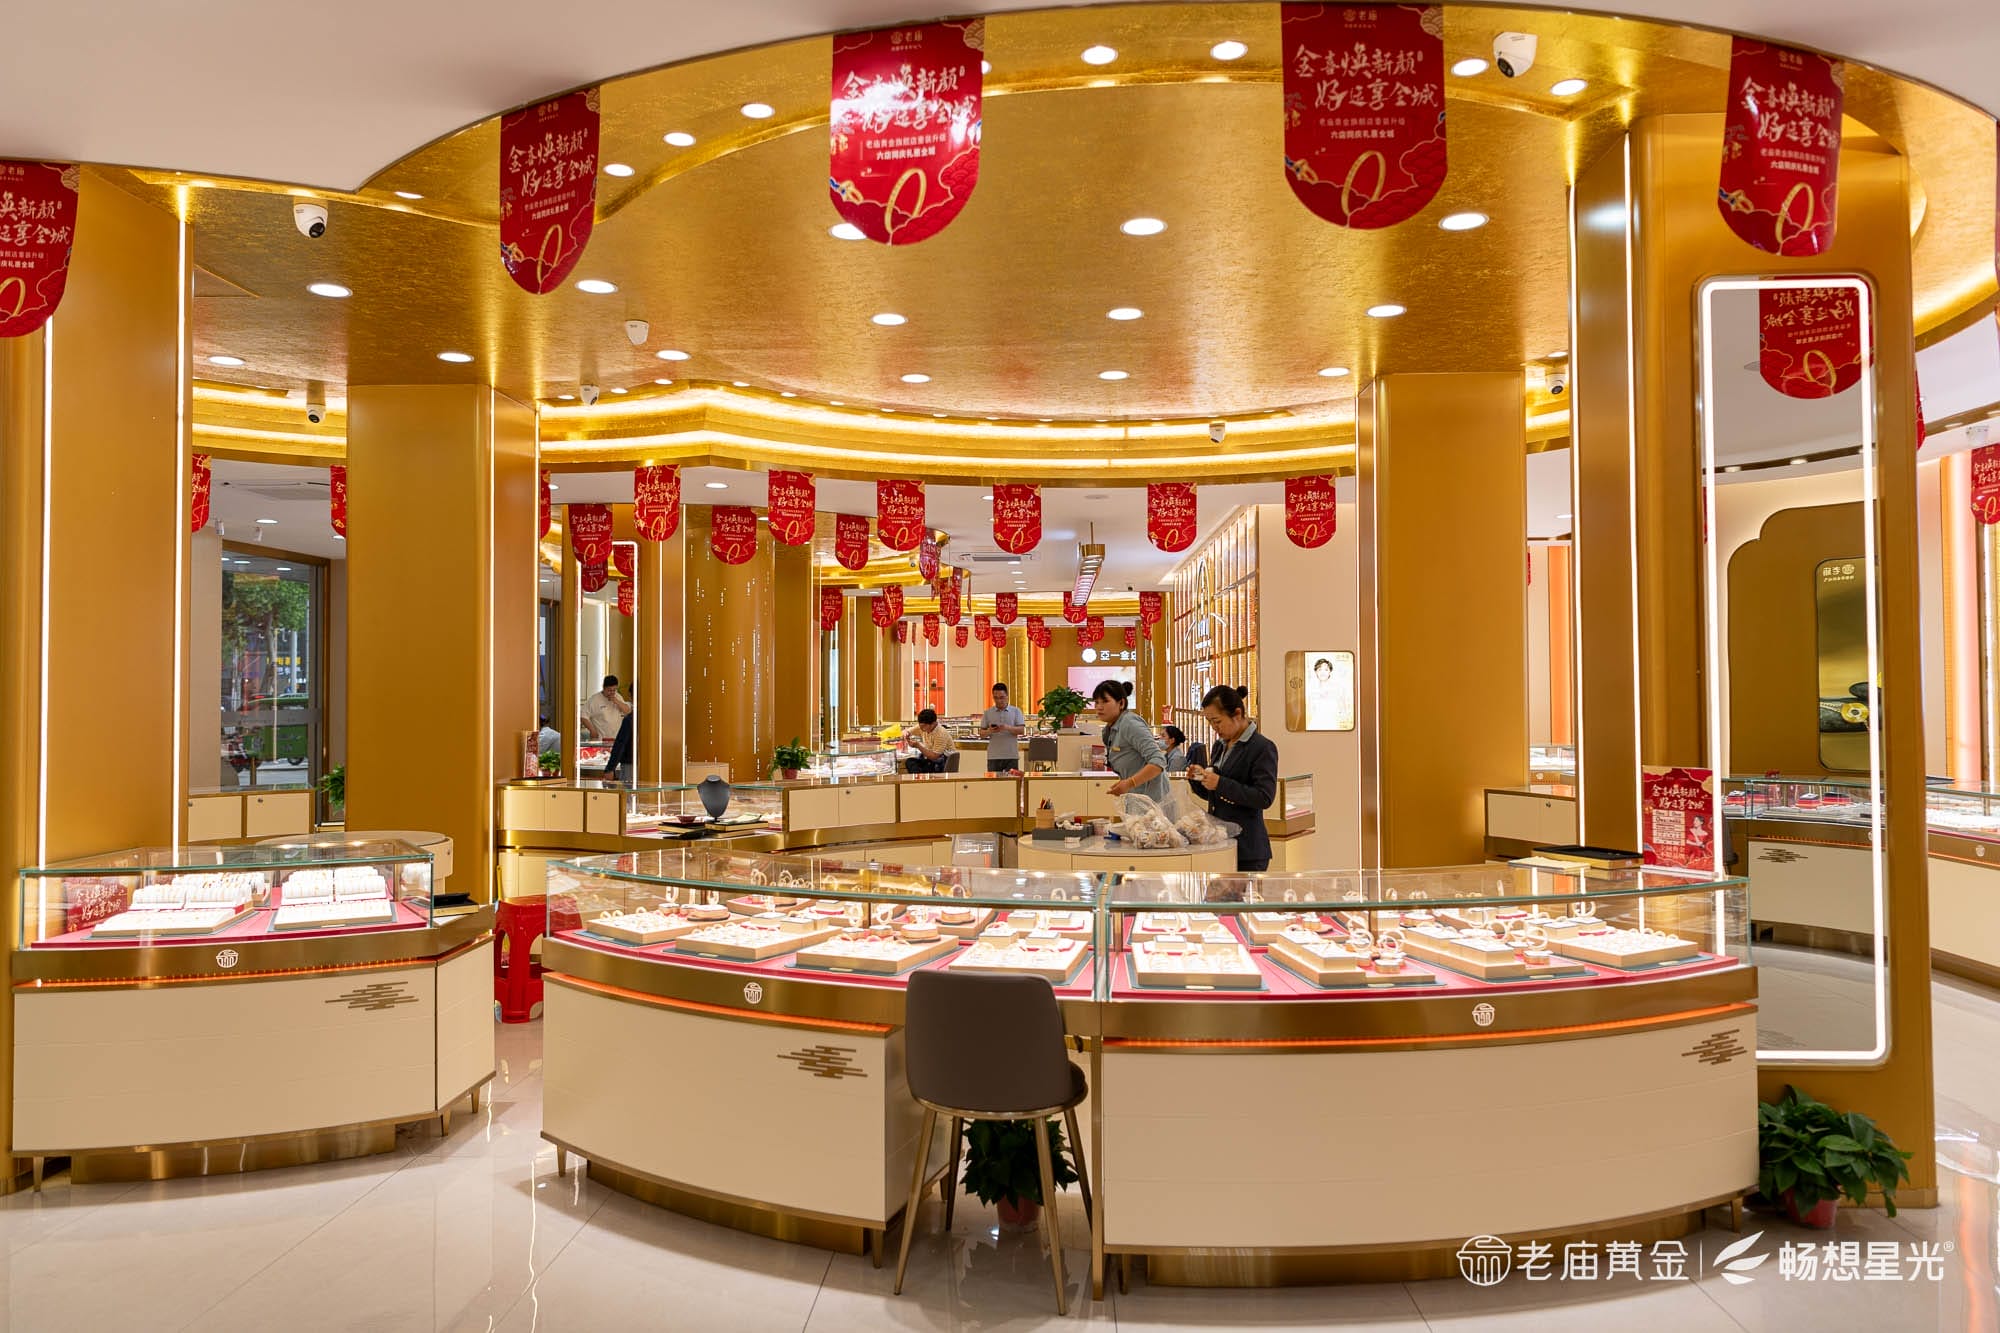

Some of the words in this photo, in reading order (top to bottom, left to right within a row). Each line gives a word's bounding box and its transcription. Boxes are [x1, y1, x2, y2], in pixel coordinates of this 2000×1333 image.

[1359, 10, 1377, 21] 老庙
[1315, 79, 1438, 111] 好运享全城
[1757, 112, 1841, 149] 好运享全城
[521, 154, 596, 197] 好运享全城
